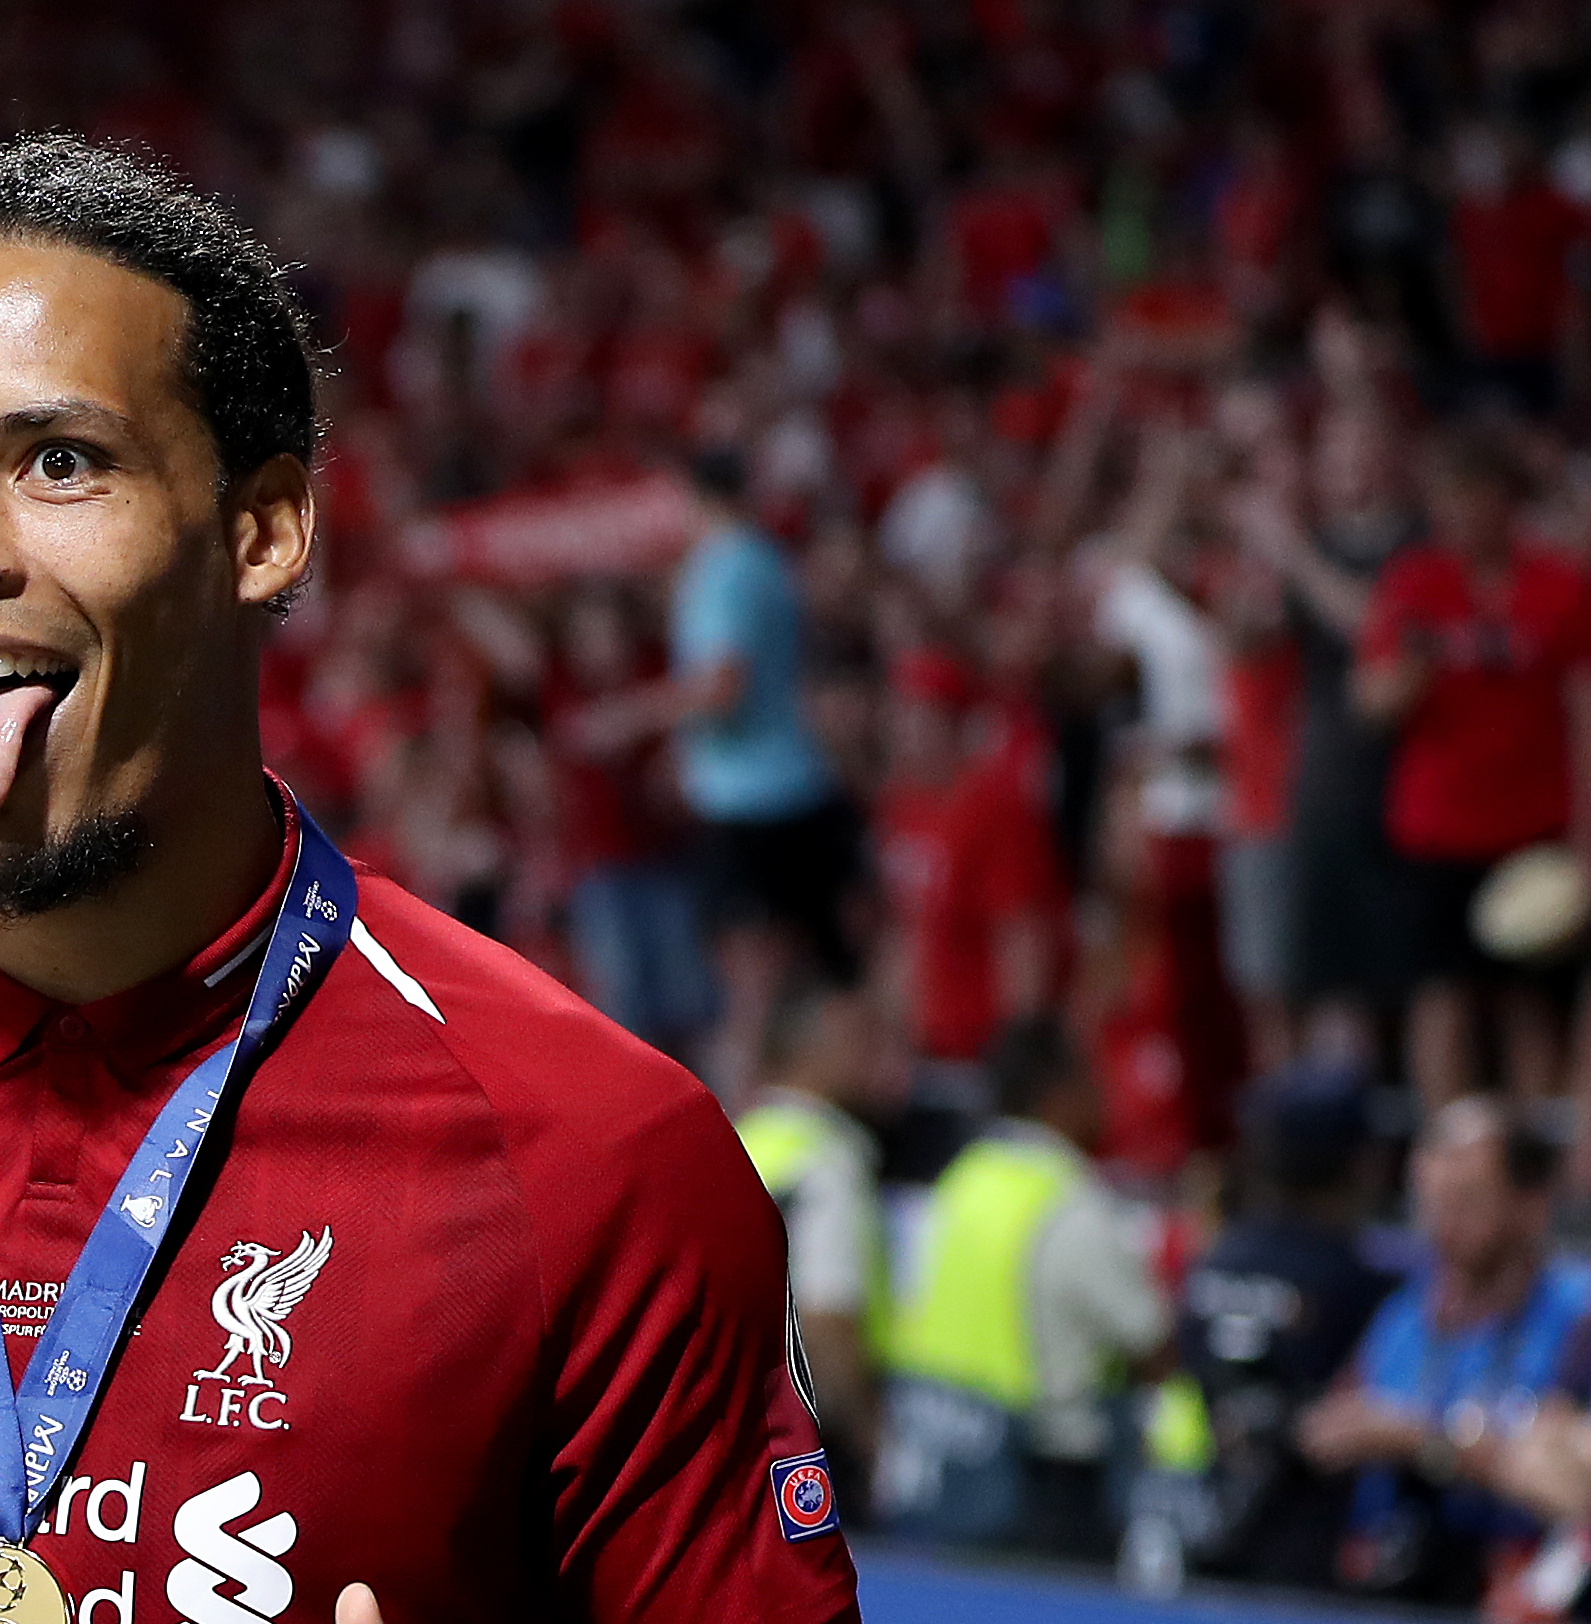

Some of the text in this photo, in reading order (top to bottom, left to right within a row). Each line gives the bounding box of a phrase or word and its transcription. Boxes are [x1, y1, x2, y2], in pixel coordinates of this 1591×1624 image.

[148, 1089, 220, 1183] INAL
[179, 1384, 290, 1430] L.F.C.
[788, 1468, 821, 1488] UEFA
